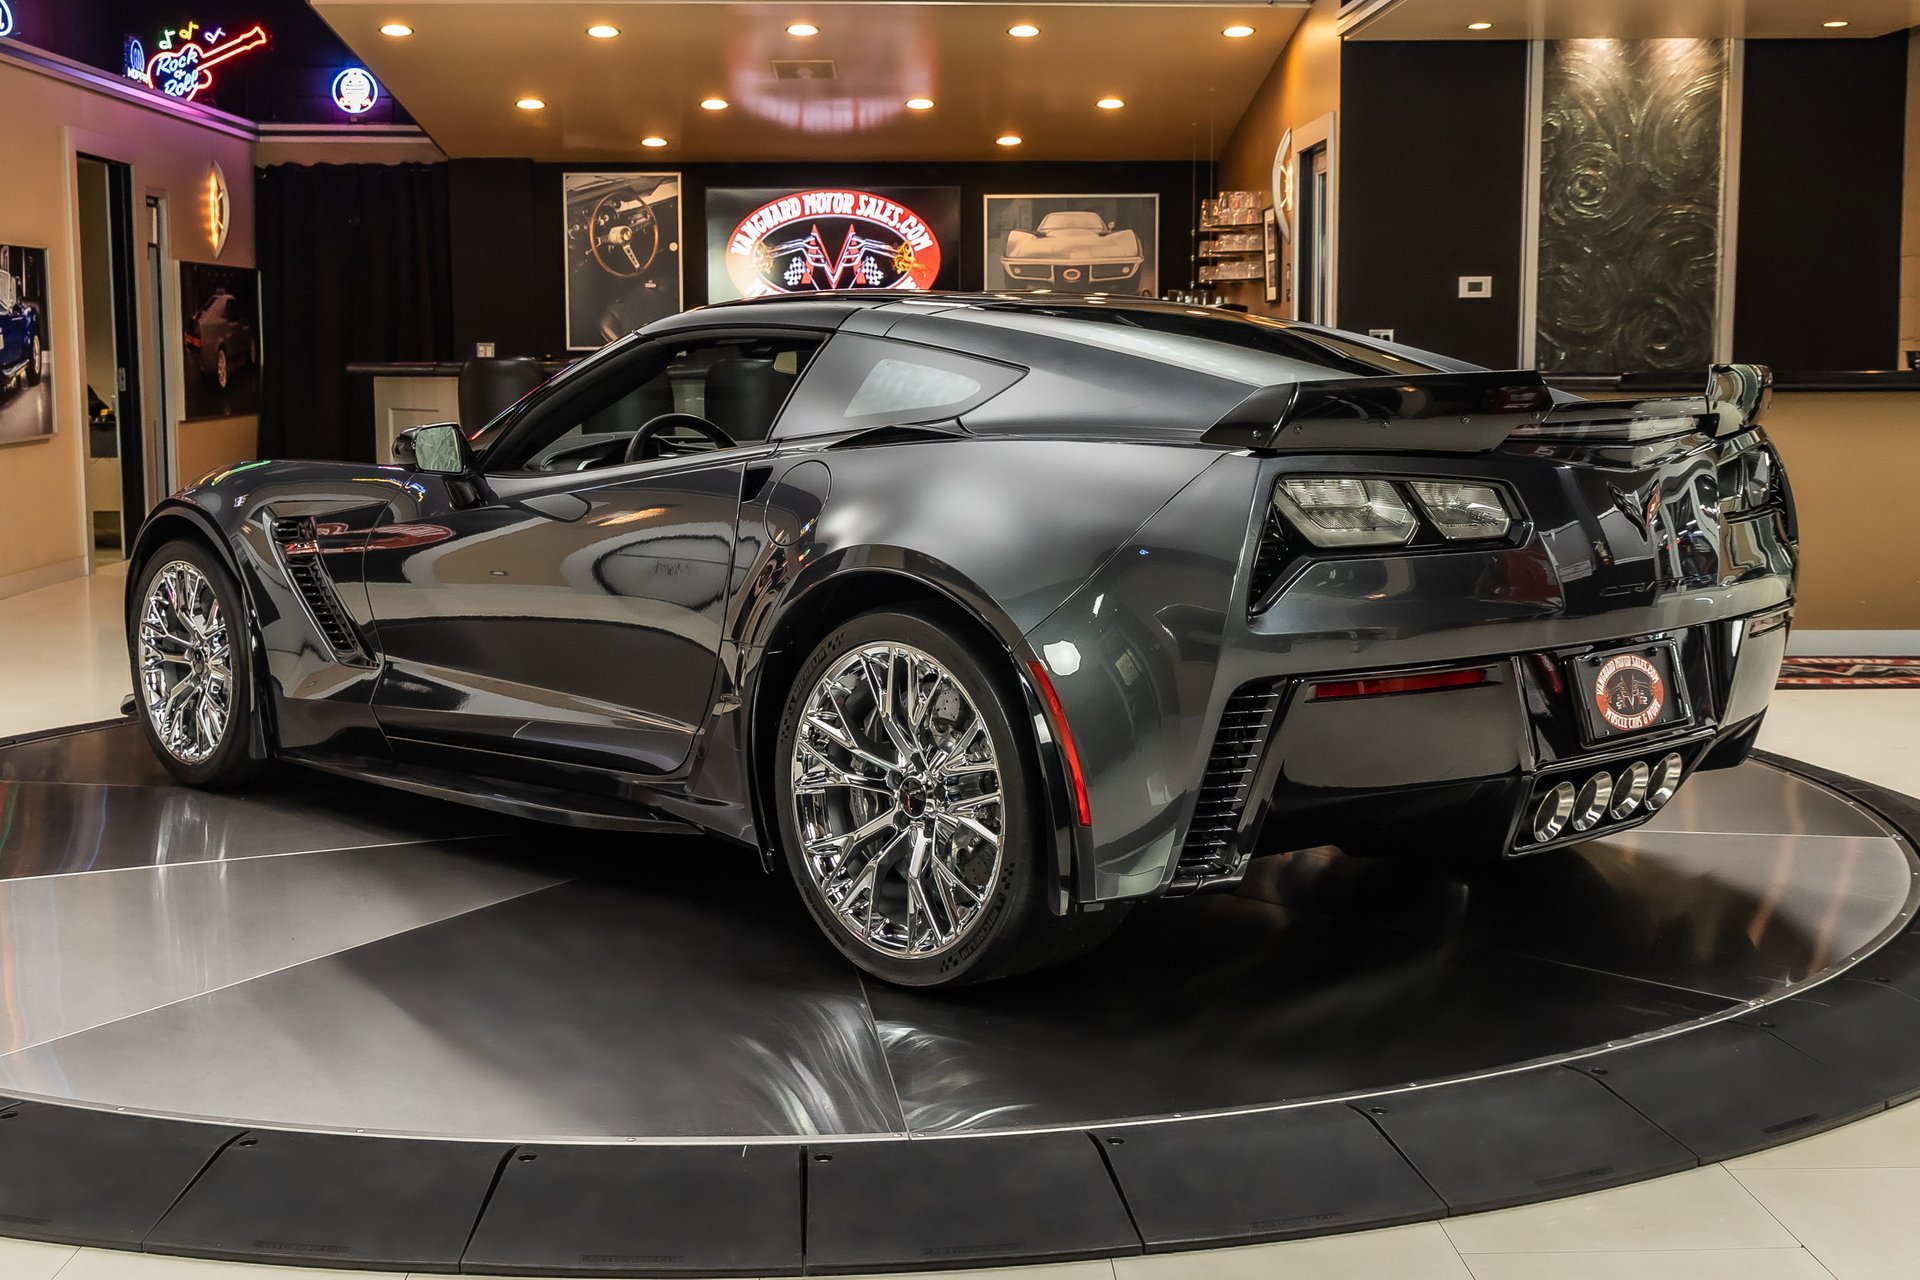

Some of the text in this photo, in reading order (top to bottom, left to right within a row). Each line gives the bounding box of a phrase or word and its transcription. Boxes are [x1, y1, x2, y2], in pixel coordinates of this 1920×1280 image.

[156, 47, 199, 76] Rock
[164, 69, 199, 97] Roll
[730, 193, 933, 256] VANGUARD MOTOR SALES.COM
[793, 647, 826, 701] MICHELIN
